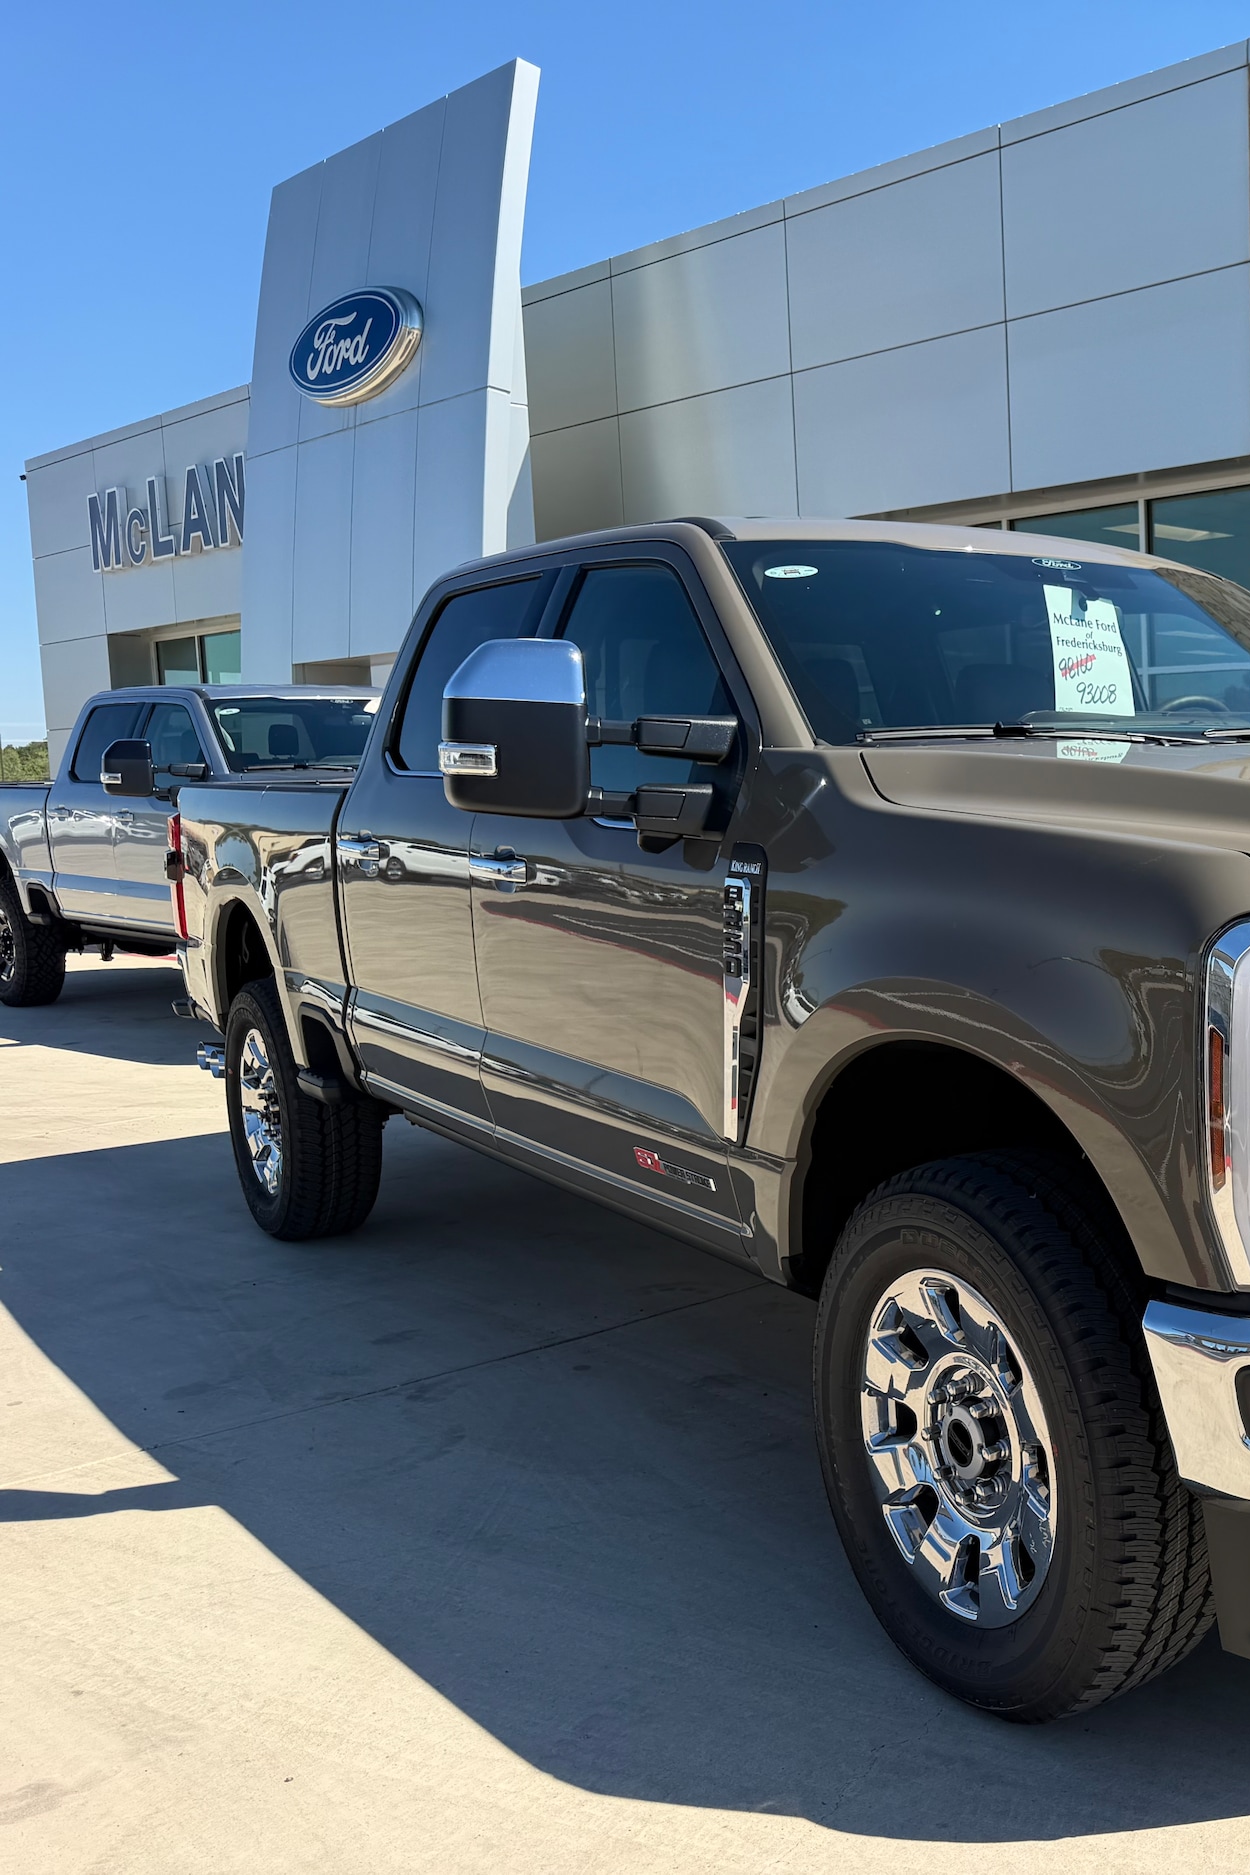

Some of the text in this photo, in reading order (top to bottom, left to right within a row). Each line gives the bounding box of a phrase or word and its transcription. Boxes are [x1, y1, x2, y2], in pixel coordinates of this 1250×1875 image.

[306, 311, 374, 381] Ford
[1053, 612, 1117, 634] McLane Ford
[1086, 631, 1093, 639] of
[1056, 636, 1123, 657] Fredericksburg
[1076, 681, 1118, 705] 93008
